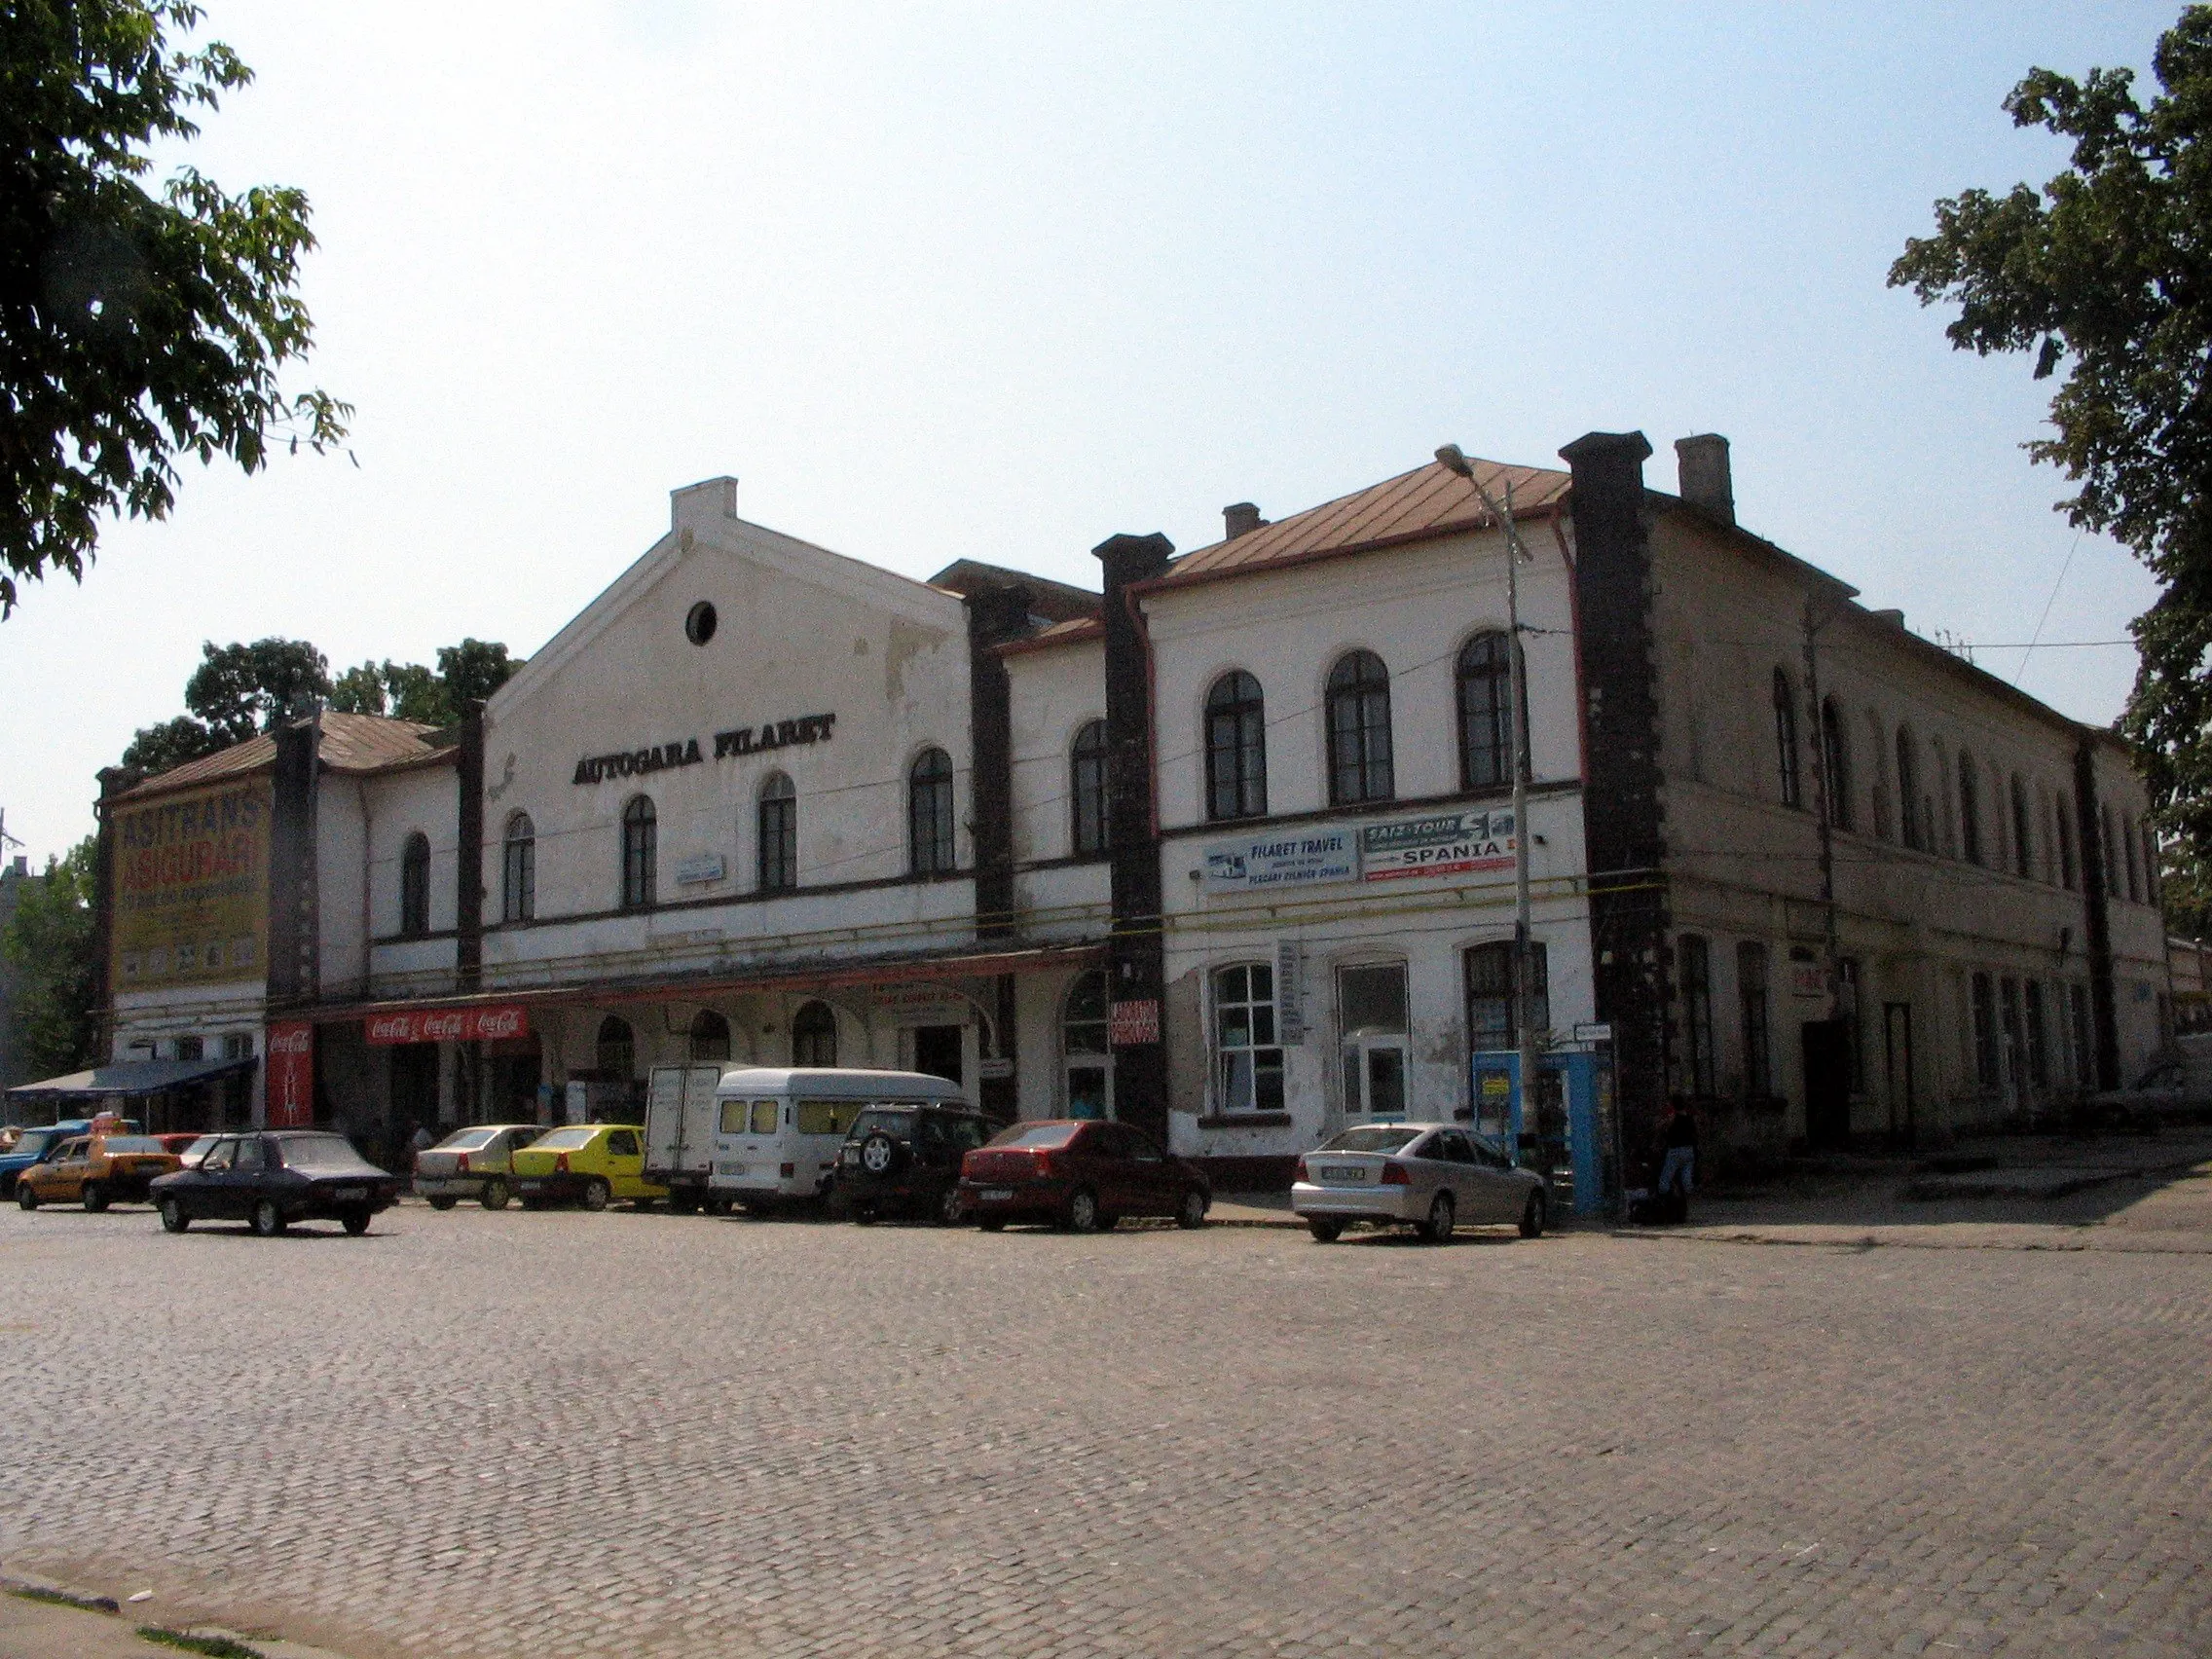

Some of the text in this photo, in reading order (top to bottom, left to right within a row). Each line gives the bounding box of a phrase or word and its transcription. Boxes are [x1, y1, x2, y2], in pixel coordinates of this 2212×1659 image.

[572, 713, 836, 785] AUTOGARA FILARET
[1251, 837, 1344, 860] FILARET TRAVEL
[1403, 841, 1500, 865] SPANIA
